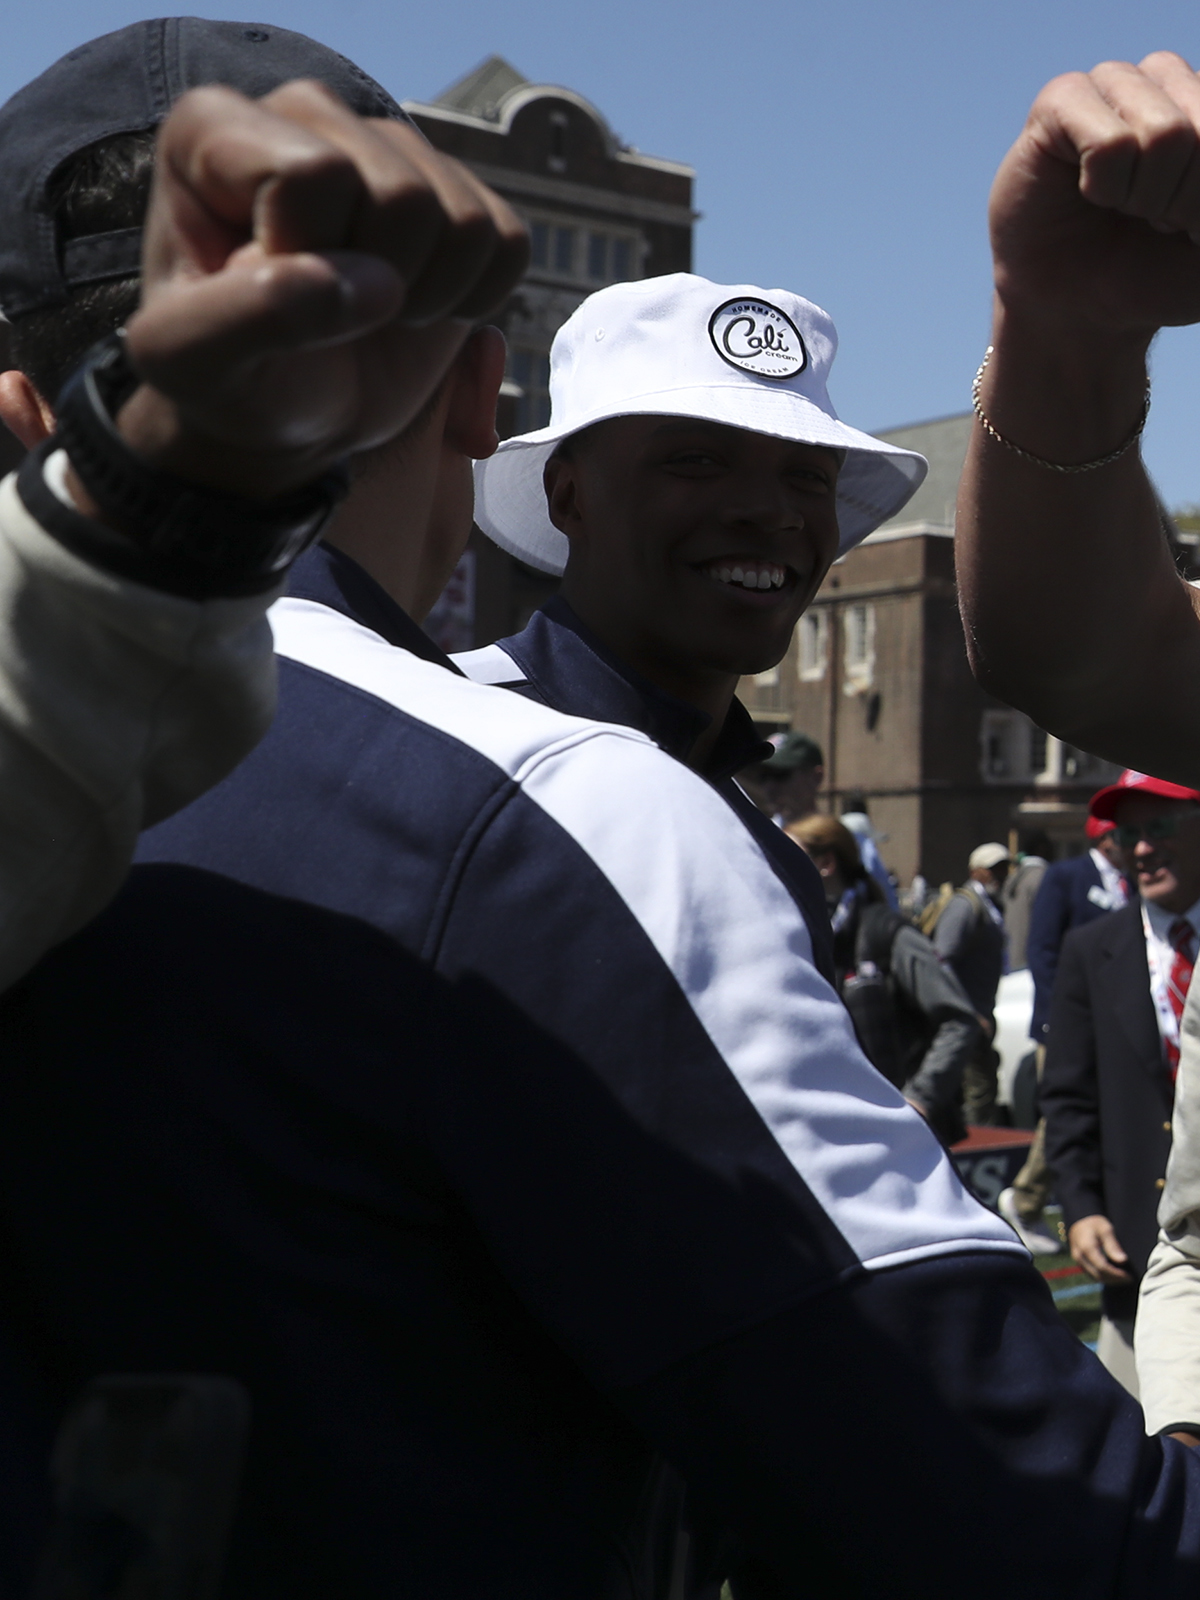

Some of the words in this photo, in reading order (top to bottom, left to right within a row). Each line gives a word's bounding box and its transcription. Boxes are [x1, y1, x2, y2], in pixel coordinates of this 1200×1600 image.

[731, 305, 781, 323] HOMEMADE
[722, 314, 789, 359] Cali
[765, 351, 798, 363] cream
